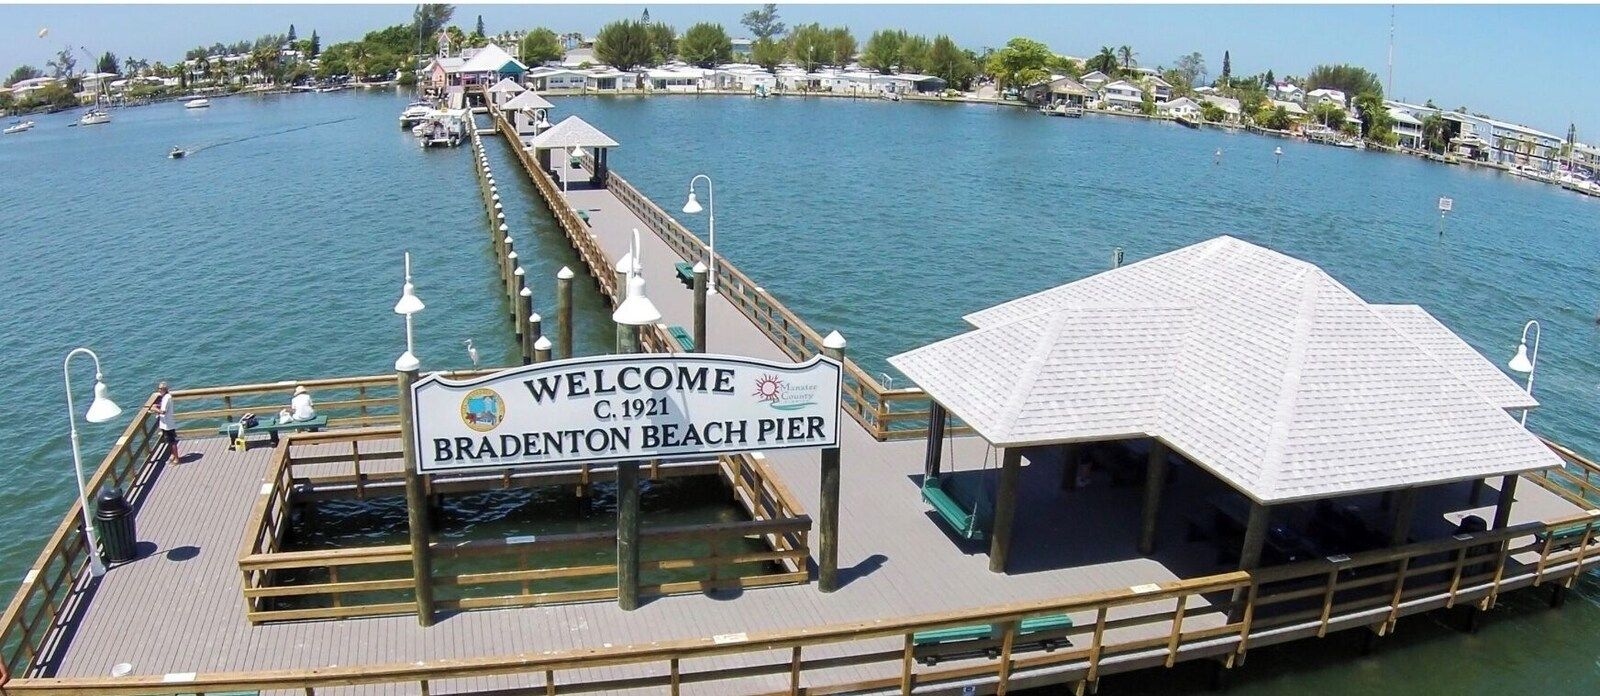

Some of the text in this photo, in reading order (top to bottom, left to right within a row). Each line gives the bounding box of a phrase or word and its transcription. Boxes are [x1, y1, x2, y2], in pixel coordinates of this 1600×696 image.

[523, 366, 735, 403] WELCOME
[780, 382, 818, 391] Manatee
[780, 391, 815, 400] County
[593, 398, 670, 420] C. 1921
[433, 415, 826, 462] BRADENTON BEACH PIER
